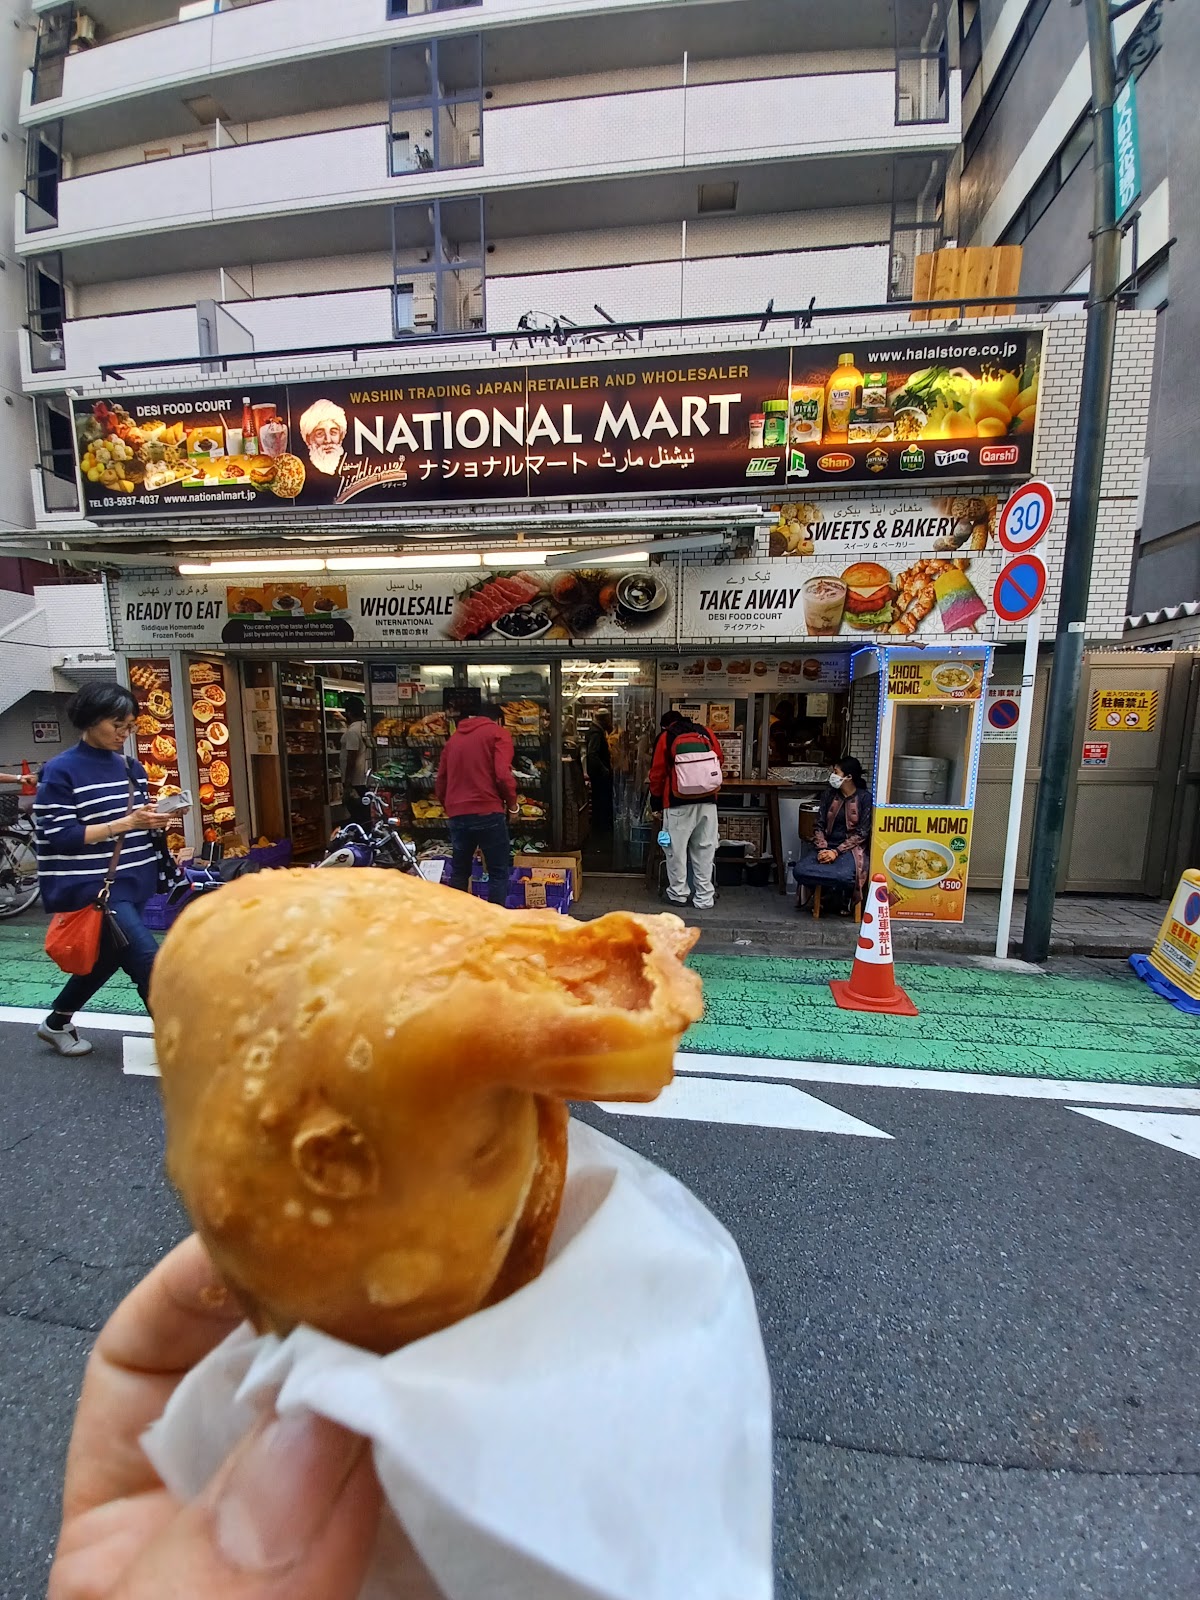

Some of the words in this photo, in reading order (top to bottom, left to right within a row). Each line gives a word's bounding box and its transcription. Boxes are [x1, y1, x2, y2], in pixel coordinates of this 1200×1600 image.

[867, 341, 1018, 363] www.halalstore.co.jp
[350, 388, 403, 404] WASHIN
[408, 383, 471, 400] TRADING
[476, 380, 522, 396] JAPAN
[528, 375, 599, 392] RETAILER
[605, 372, 636, 388] AND
[641, 365, 749, 384] WHOLESALER
[136, 405, 162, 418] DESI
[163, 402, 193, 416] FOOD
[195, 399, 232, 413] COURT
[354, 403, 583, 456] NATIONAL
[593, 393, 742, 443] MART
[597, 447, 644, 473] مارٹ
[649, 445, 695, 469] نیشنل
[820, 457, 850, 468] Shan
[902, 455, 922, 463] VITAL
[936, 452, 967, 466] Vivo
[982, 448, 1016, 462] Qarshi
[418, 451, 588, 481] ナショナルマート
[89, 499, 103, 508] TEL
[103, 494, 160, 507] 03-5937-4037
[164, 490, 257, 504] www.nationalmart.jp
[1010, 500, 1041, 535] 30
[804, 520, 871, 541] SWEETS
[873, 519, 887, 539] &
[891, 516, 960, 538] BAKERY
[843, 542, 870, 550] スイーツ
[360, 596, 455, 617] WHOLESALE
[699, 589, 743, 611] TAKE
[744, 588, 802, 610] AWAY
[126, 602, 172, 621] READY
[174, 601, 193, 620] TO
[196, 600, 223, 619] EAT
[708, 613, 727, 621] DESI
[753, 612, 783, 620] COURT
[141, 624, 169, 632] Siddique
[169, 623, 205, 631] Homemade
[375, 618, 434, 626] INTERNATIONAL
[723, 623, 766, 631] テイクアウト
[174, 631, 195, 639] Foods
[888, 664, 924, 679] JHOOL
[887, 680, 921, 695] MOMO
[1101, 697, 1149, 709] 駐輪禁止
[878, 815, 922, 833] JHOOL
[926, 816, 969, 835] MOMO
[939, 880, 961, 890] ¥500
[877, 906, 890, 957] 駐車禁止
